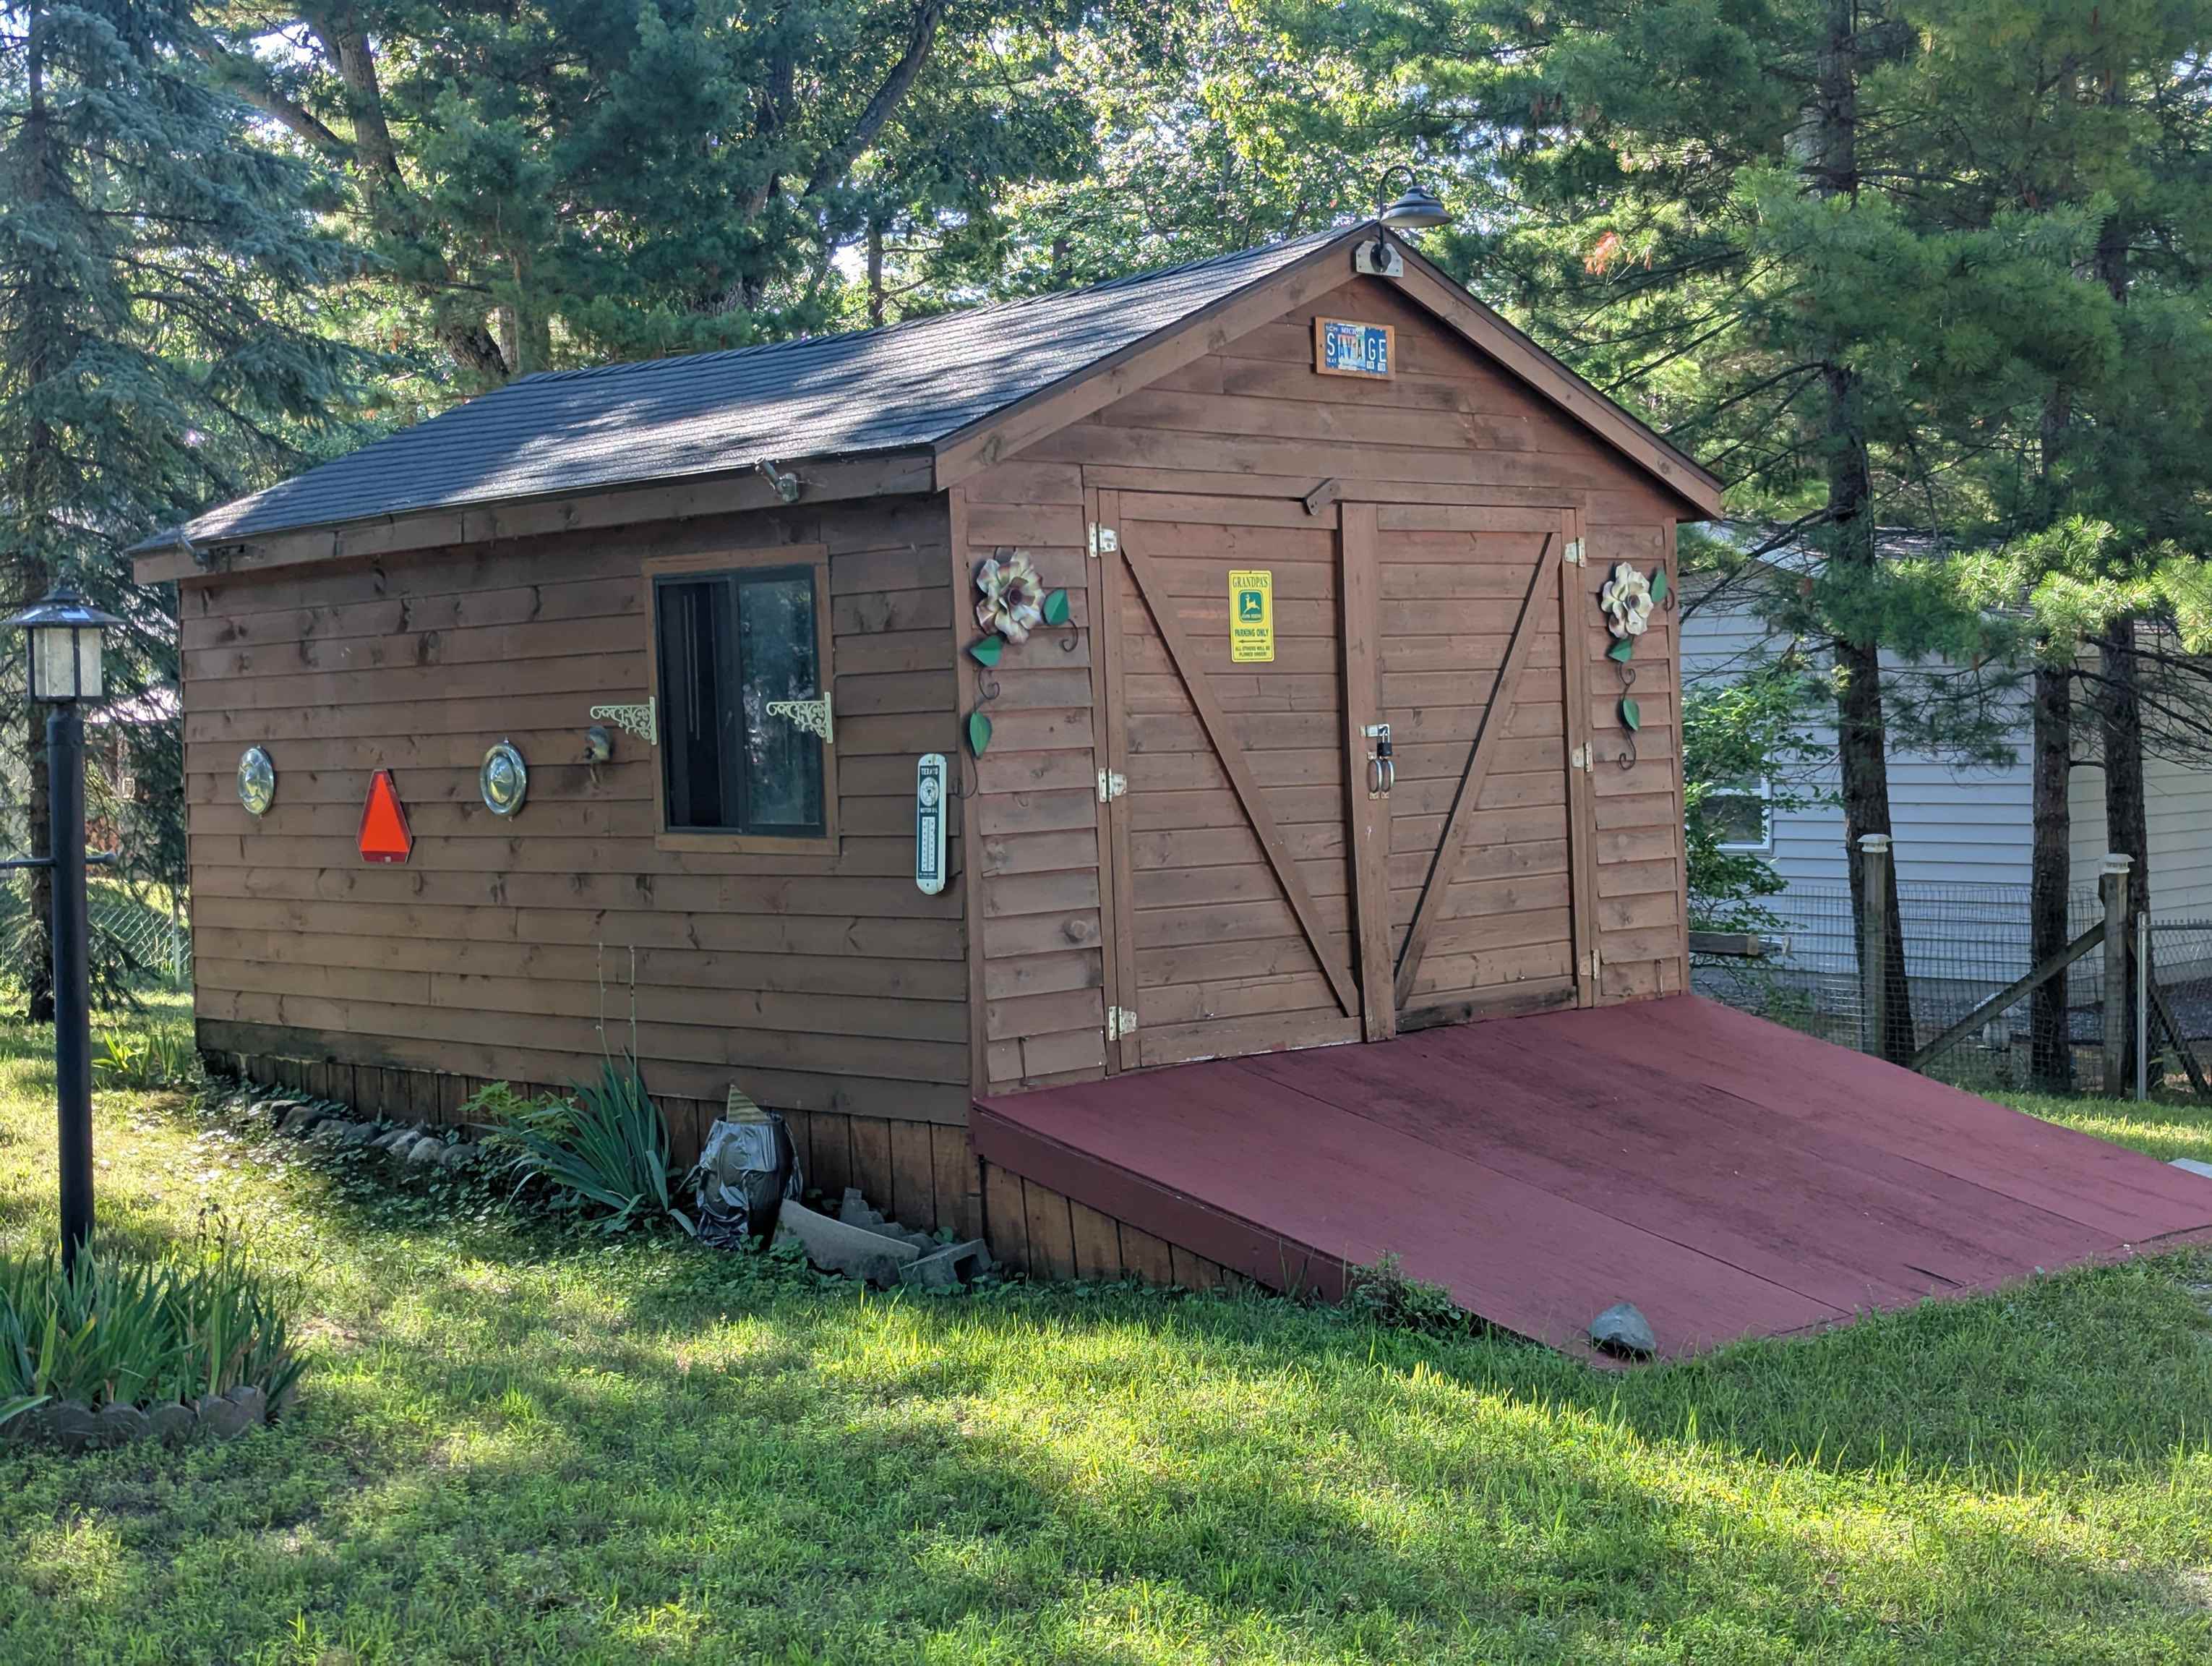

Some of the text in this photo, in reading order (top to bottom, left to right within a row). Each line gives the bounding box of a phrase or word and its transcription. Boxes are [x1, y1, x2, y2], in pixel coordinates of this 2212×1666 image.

[1327, 332, 1387, 363] SAVAGE
[1235, 628, 1269, 637] PARKING ONLY
